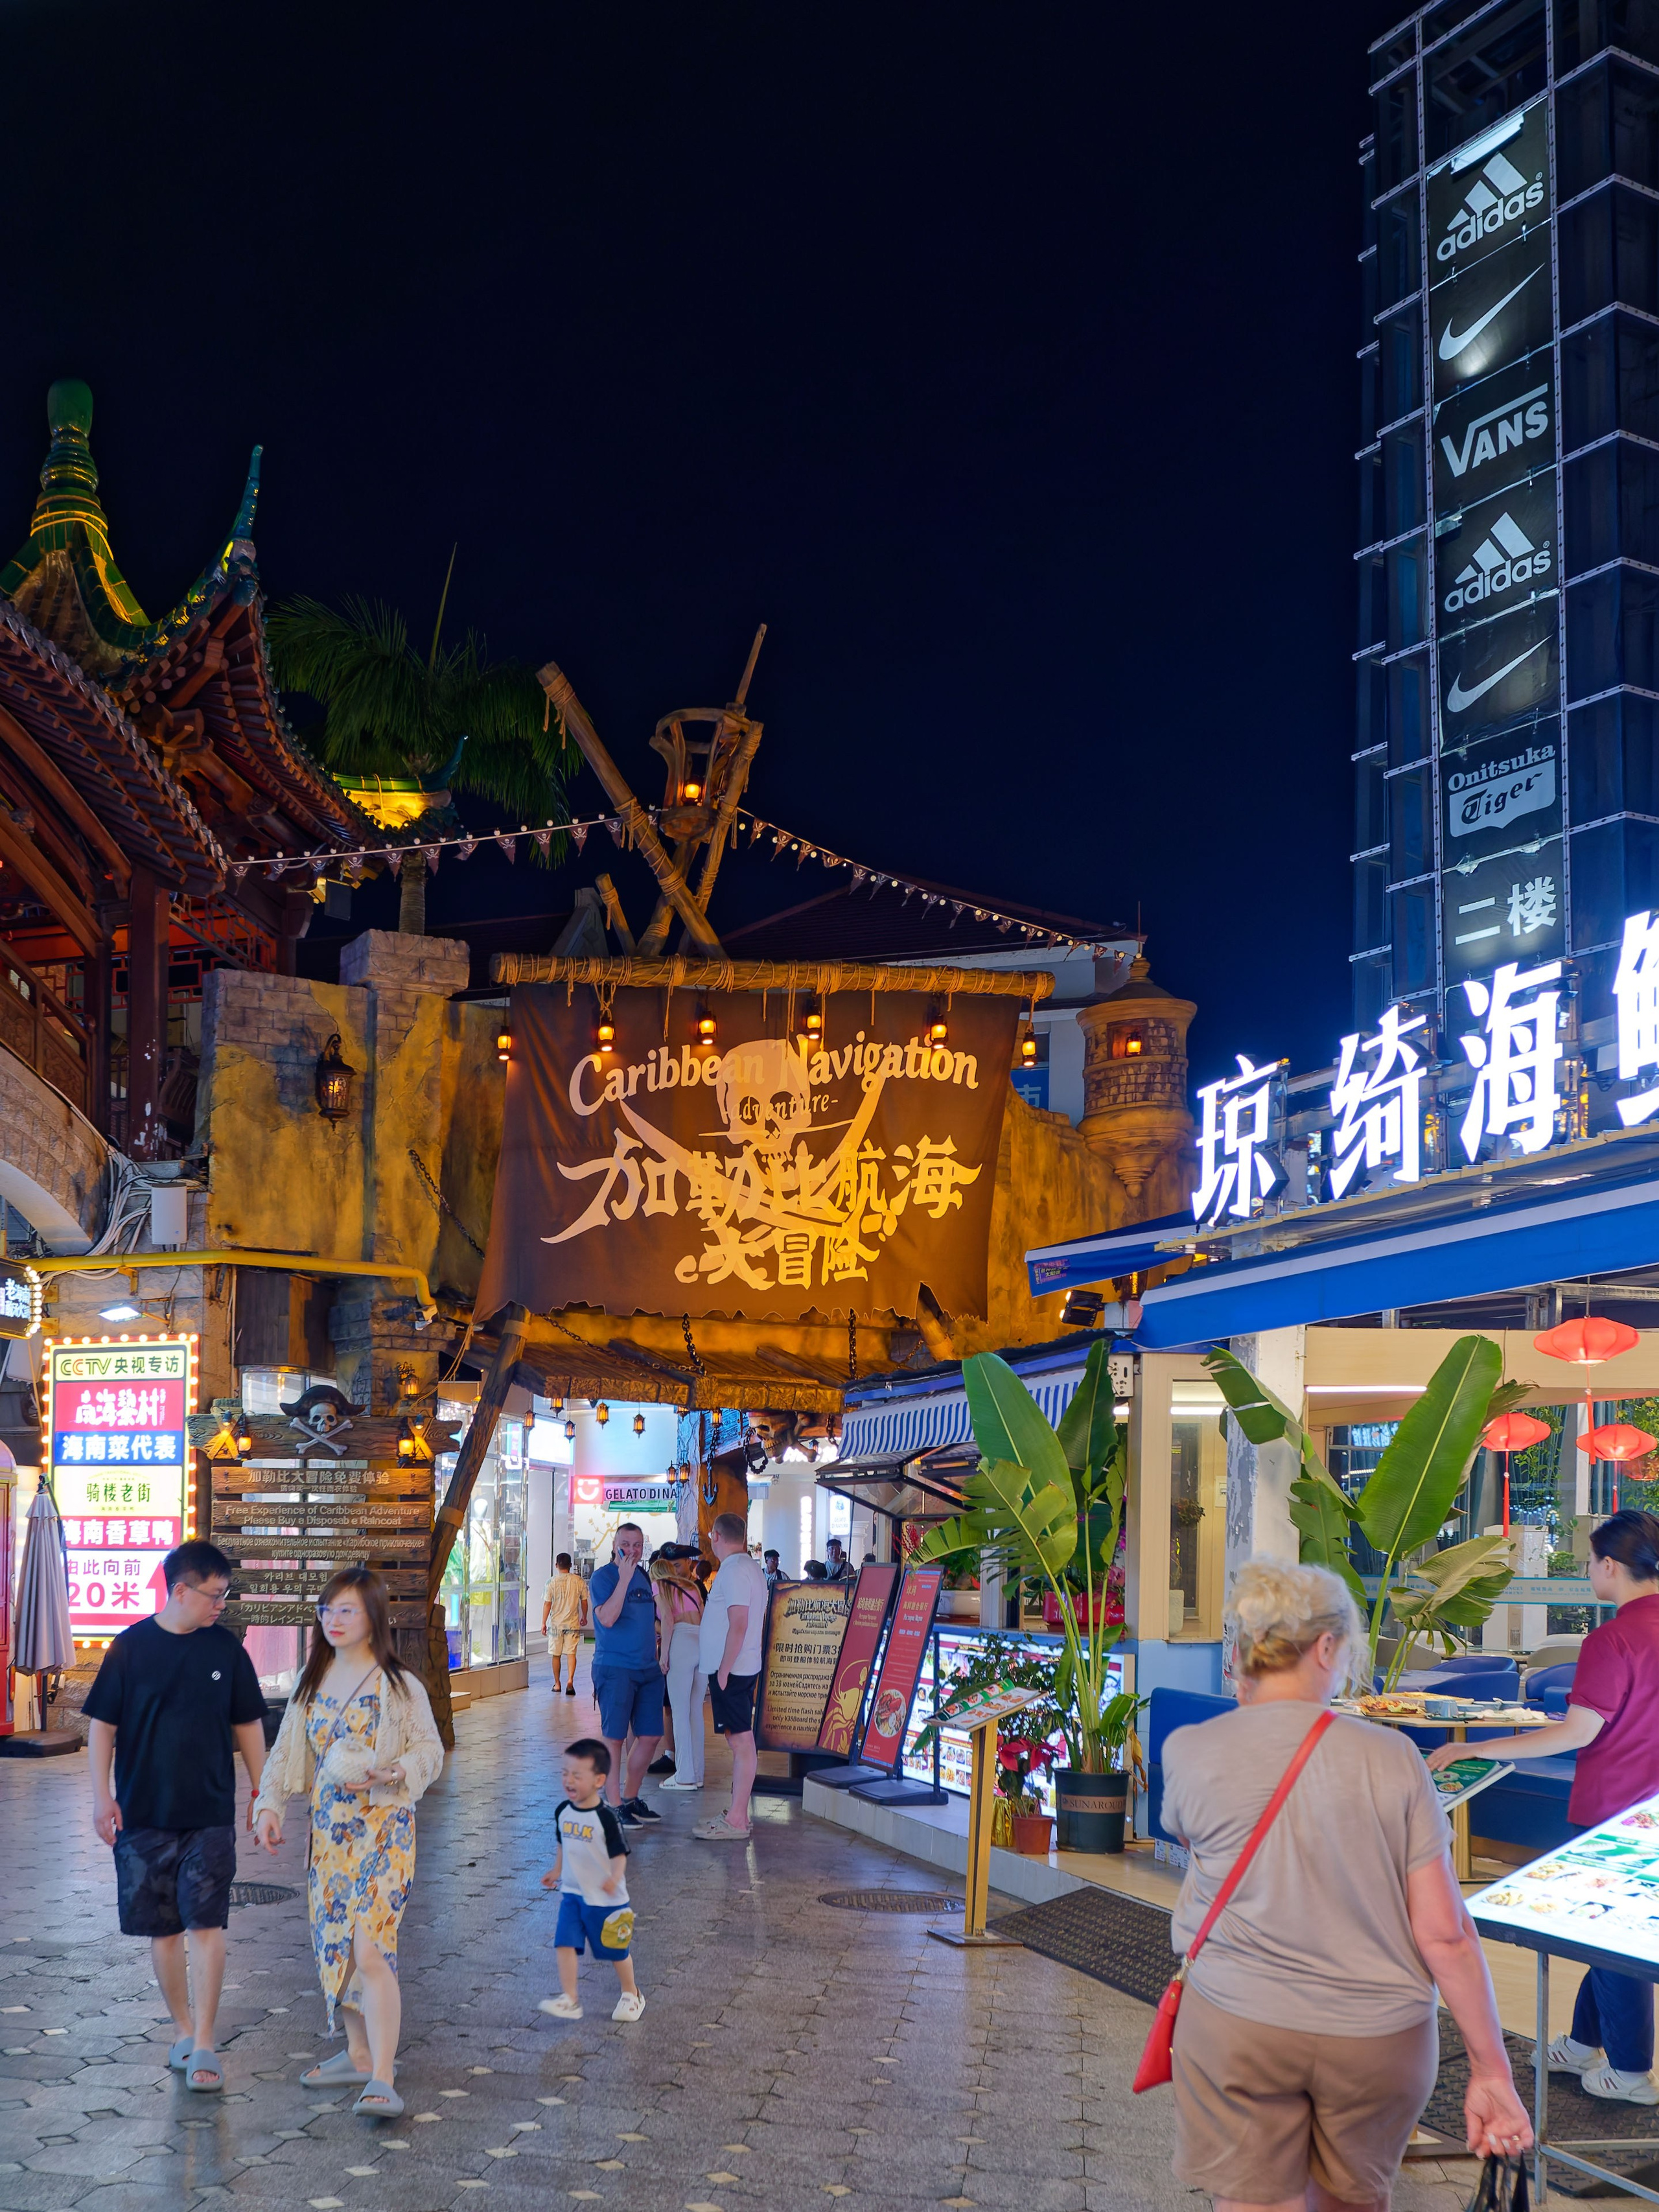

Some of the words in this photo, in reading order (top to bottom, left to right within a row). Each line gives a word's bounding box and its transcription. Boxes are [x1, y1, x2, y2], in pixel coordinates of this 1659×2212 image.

[1436, 182, 1544, 262] adidas
[1440, 383, 1548, 478] VANS
[1444, 547, 1551, 613] adidas
[1448, 745, 1555, 791] Onitsuka
[1461, 772, 1542, 824] Tiger
[1455, 876, 1557, 944] 二楼
[568, 1044, 763, 1116] Caribbean
[779, 1030, 980, 1095] Navigation
[540, 1128, 982, 1244] 加勒比航海
[704, 1225, 881, 1291] 大冒险
[60, 1358, 111, 1376] CCTV
[115, 1355, 180, 1375] 央视专访
[62, 1434, 176, 1460] 海南菜代表
[248, 1470, 390, 1484] 加勒比大冒险免费体验
[87, 1483, 150, 1502] 骑楼老街
[605, 1489, 646, 1500] GELATO
[227, 1506, 248, 1515] Free
[251, 1506, 305, 1517] Experience
[308, 1505, 318, 1515] of
[320, 1506, 367, 1515] Caribbean
[369, 1506, 420, 1515] Adventure
[244, 1516, 276, 1525] Please
[278, 1516, 296, 1526] Buy
[360, 1516, 402, 1525] Raincoat
[63, 1519, 173, 1545] 海南香草鸭
[217, 1536, 253, 1547] Бесплатное
[272, 1550, 292, 1560] купите
[67, 1559, 141, 1576] 由此向前
[264, 1572, 294, 1582] 카리브
[299, 1572, 328, 1582] 대모험
[69, 1581, 140, 1609] 20米
[249, 1583, 279, 1594] 일회용
[283, 1584, 302, 1594] 우의
[770, 1670, 802, 1679] Ограниченная
[803, 1673, 830, 1682] распродажа
[767, 1705, 788, 1713] Limited
[788, 1706, 800, 1714] time
